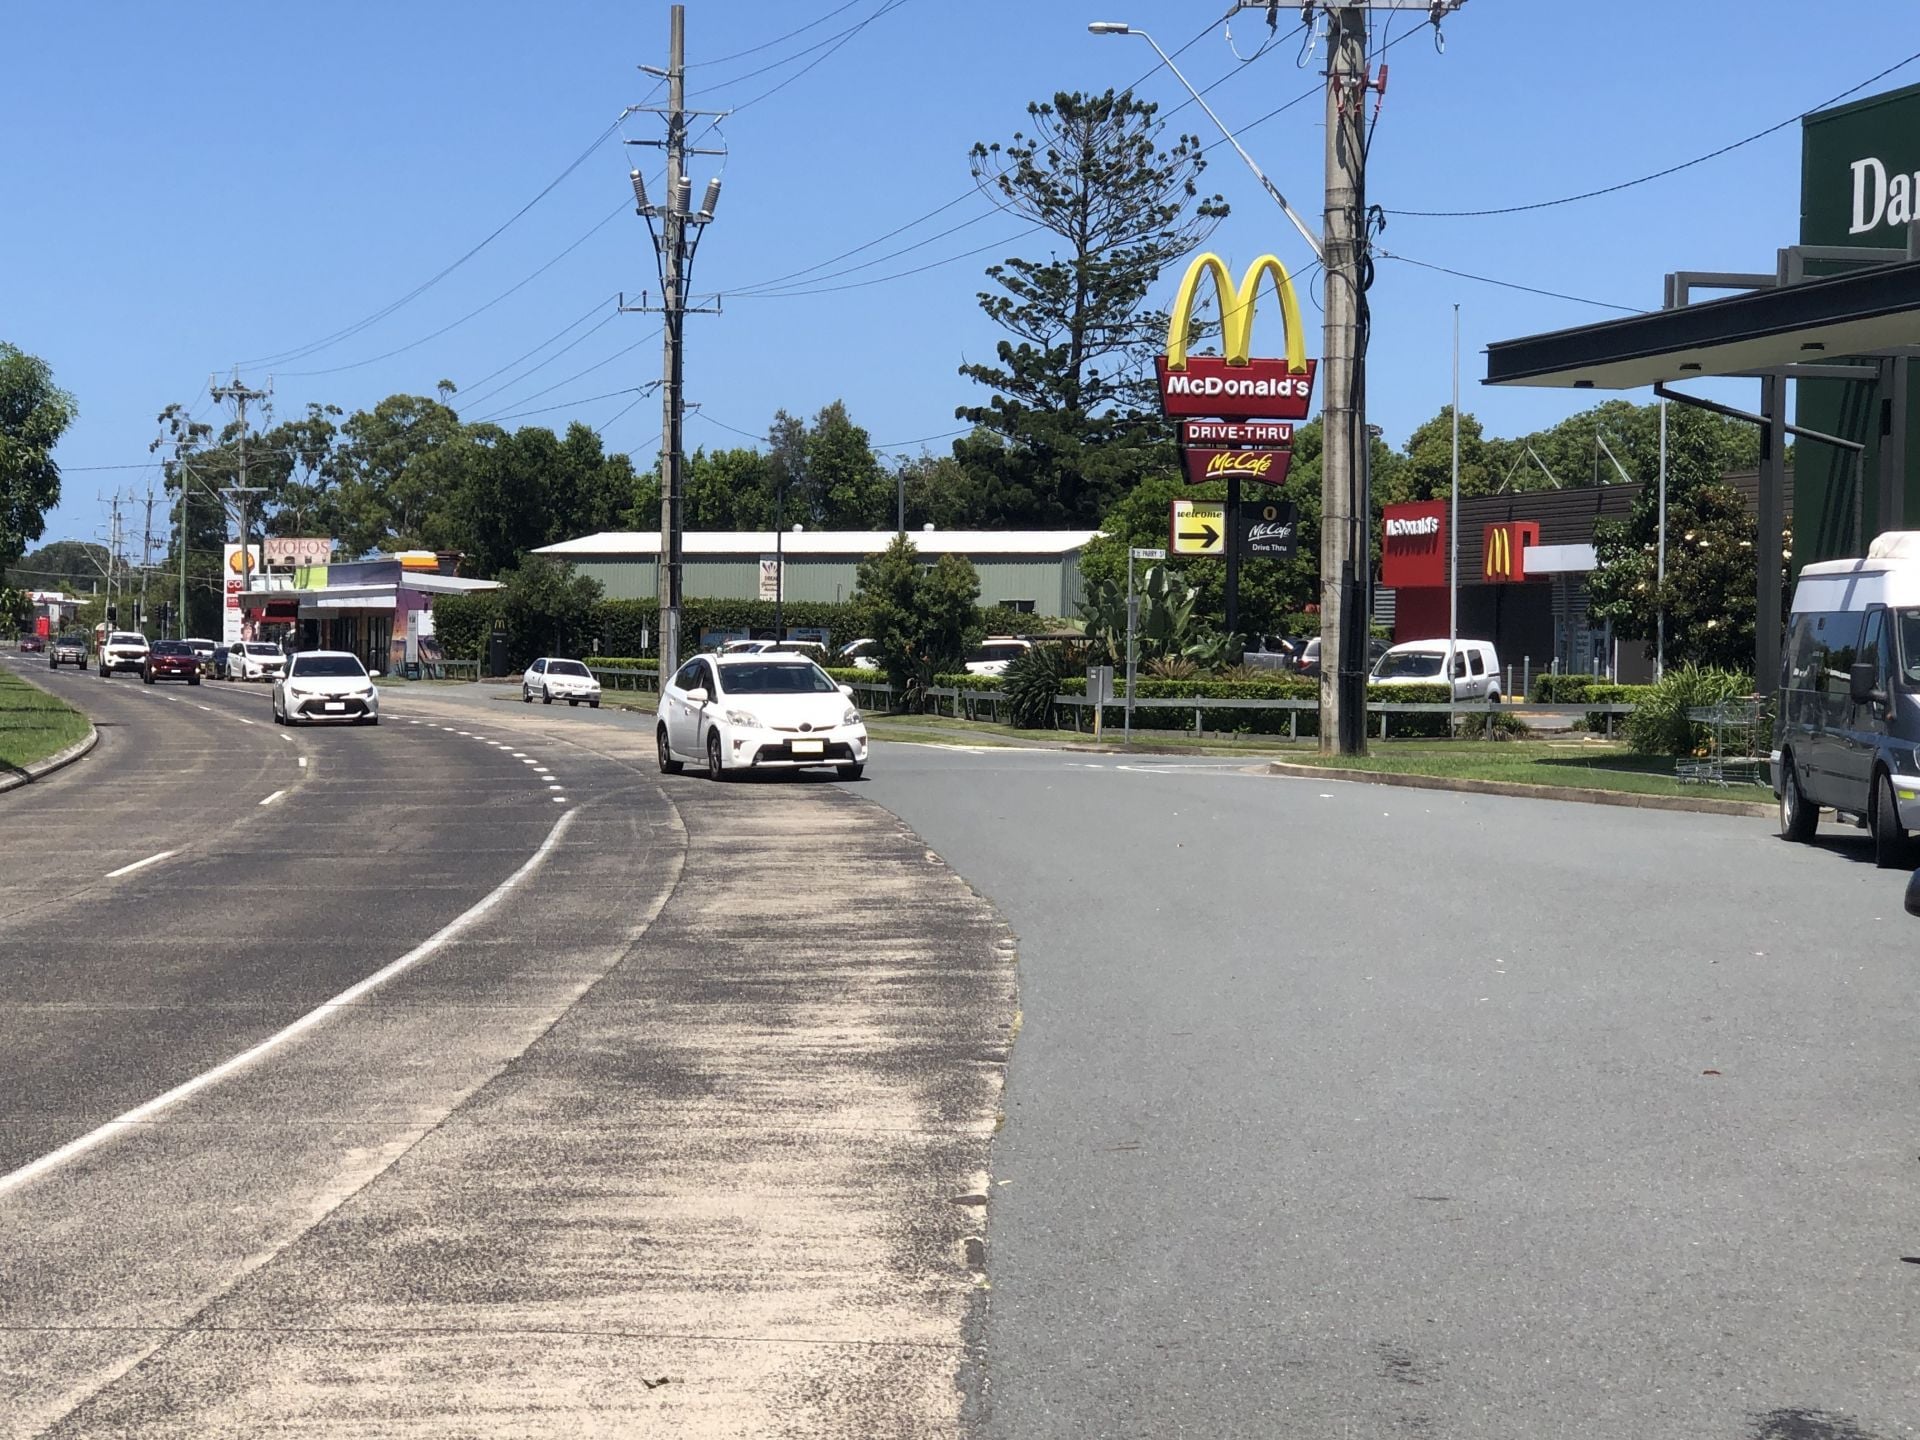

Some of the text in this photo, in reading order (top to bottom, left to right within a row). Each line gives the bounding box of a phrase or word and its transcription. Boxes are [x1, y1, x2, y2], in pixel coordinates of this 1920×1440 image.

[1167, 376, 1309, 397] McDonald's
[1189, 425, 1290, 440] DRIVE-THRU
[1177, 508, 1222, 519] welcome
[267, 541, 329, 555] MOFOS
[1252, 543, 1287, 552] Drive Thru
